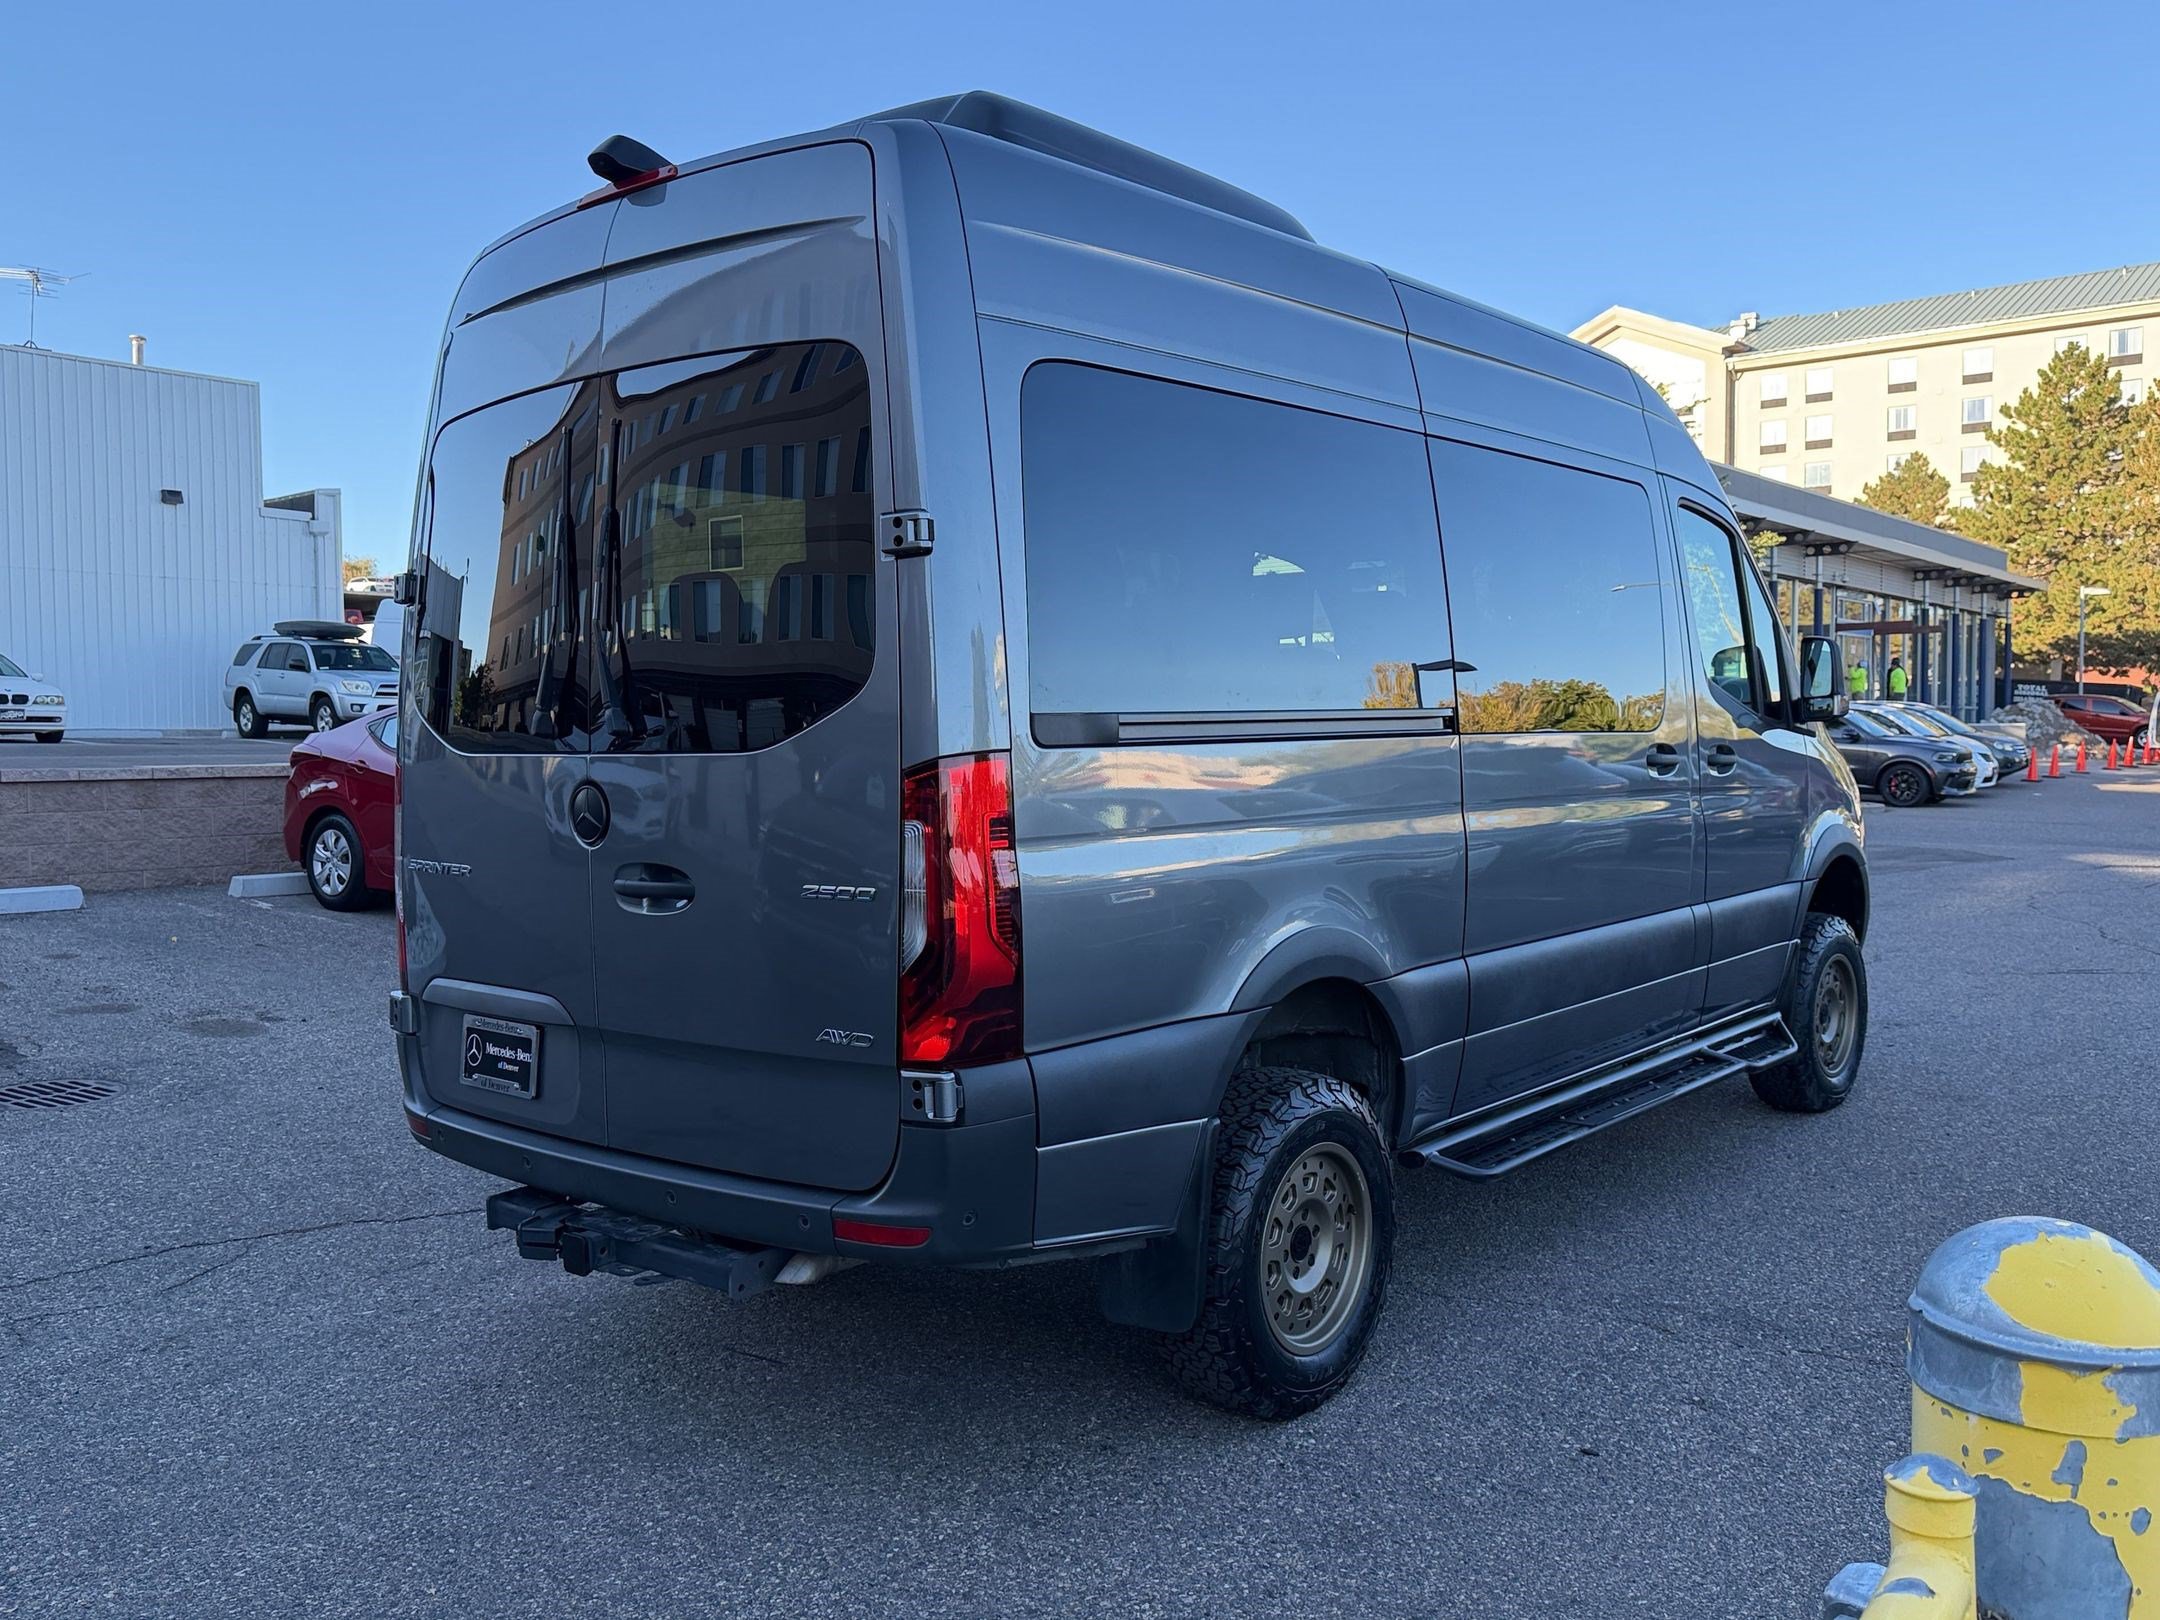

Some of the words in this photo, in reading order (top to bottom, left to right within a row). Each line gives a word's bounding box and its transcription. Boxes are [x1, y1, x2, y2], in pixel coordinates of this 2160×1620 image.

[2017, 683, 2046, 691] TOTAL
[408, 858, 472, 878] SPRINTER
[800, 884, 876, 901] 2500
[815, 1028, 874, 1048] AWD
